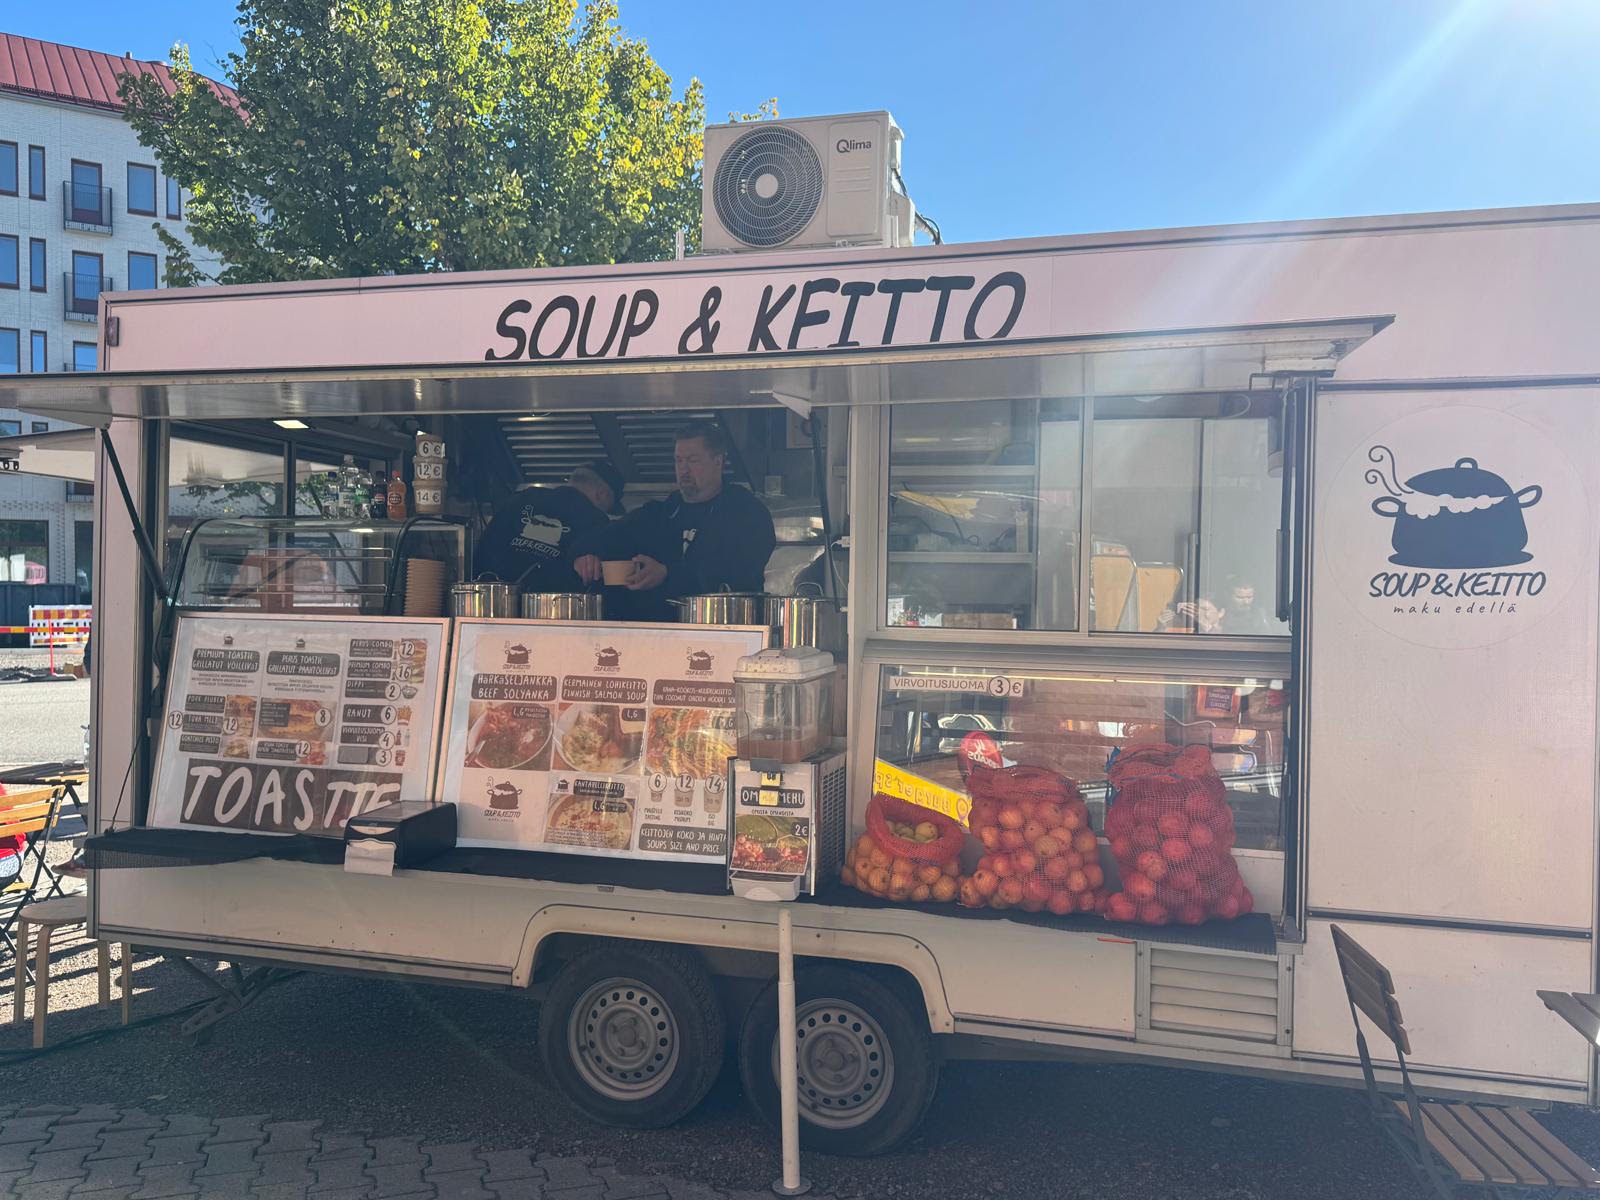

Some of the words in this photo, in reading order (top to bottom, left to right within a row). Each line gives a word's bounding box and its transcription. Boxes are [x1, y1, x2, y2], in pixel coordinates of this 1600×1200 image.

[836, 139, 872, 153] Qlima
[485, 288, 660, 361] SOUP
[677, 286, 723, 355] &
[422, 442, 429, 454] 6
[433, 445, 441, 455] €
[420, 464, 430, 475] 12
[433, 466, 441, 476] €
[417, 492, 429, 502] 14
[432, 492, 440, 503] €
[1393, 601, 1442, 614] maku
[1455, 601, 1517, 614] edellä
[371, 640, 393, 648] COMBO
[402, 643, 413, 656] 12
[399, 664, 410, 680] 16
[563, 678, 602, 688] KERMAINEN
[605, 680, 647, 690] LOHIKEITTO
[894, 678, 985, 690] VIRVOITUSJUOMA
[995, 680, 1004, 694] 3
[1011, 682, 1022, 695] €
[389, 685, 396, 698] 2
[478, 687, 498, 699] BEEF
[503, 688, 549, 700] SOLYANKA
[562, 688, 591, 698] FINNISH
[594, 690, 623, 699] SALMON
[627, 691, 646, 701] SOUP
[171, 713, 181, 727] 12
[320, 709, 326, 724] 8
[346, 708, 372, 719] RANUT
[385, 706, 391, 721] 6
[225, 718, 237, 731] 12
[382, 733, 390, 747] 4
[298, 742, 309, 755] 12
[379, 750, 387, 764] 3
[654, 774, 661, 788] 6
[680, 774, 692, 788] 12
[709, 775, 722, 791] 14
[641, 828, 674, 839] KEITTOJEN
[676, 830, 695, 841] KOKO
[697, 831, 706, 841] JA
[647, 839, 667, 849] SOUPS
[670, 841, 683, 851] SIZE
[685, 842, 700, 852] AND
[702, 844, 720, 854] PRICE
